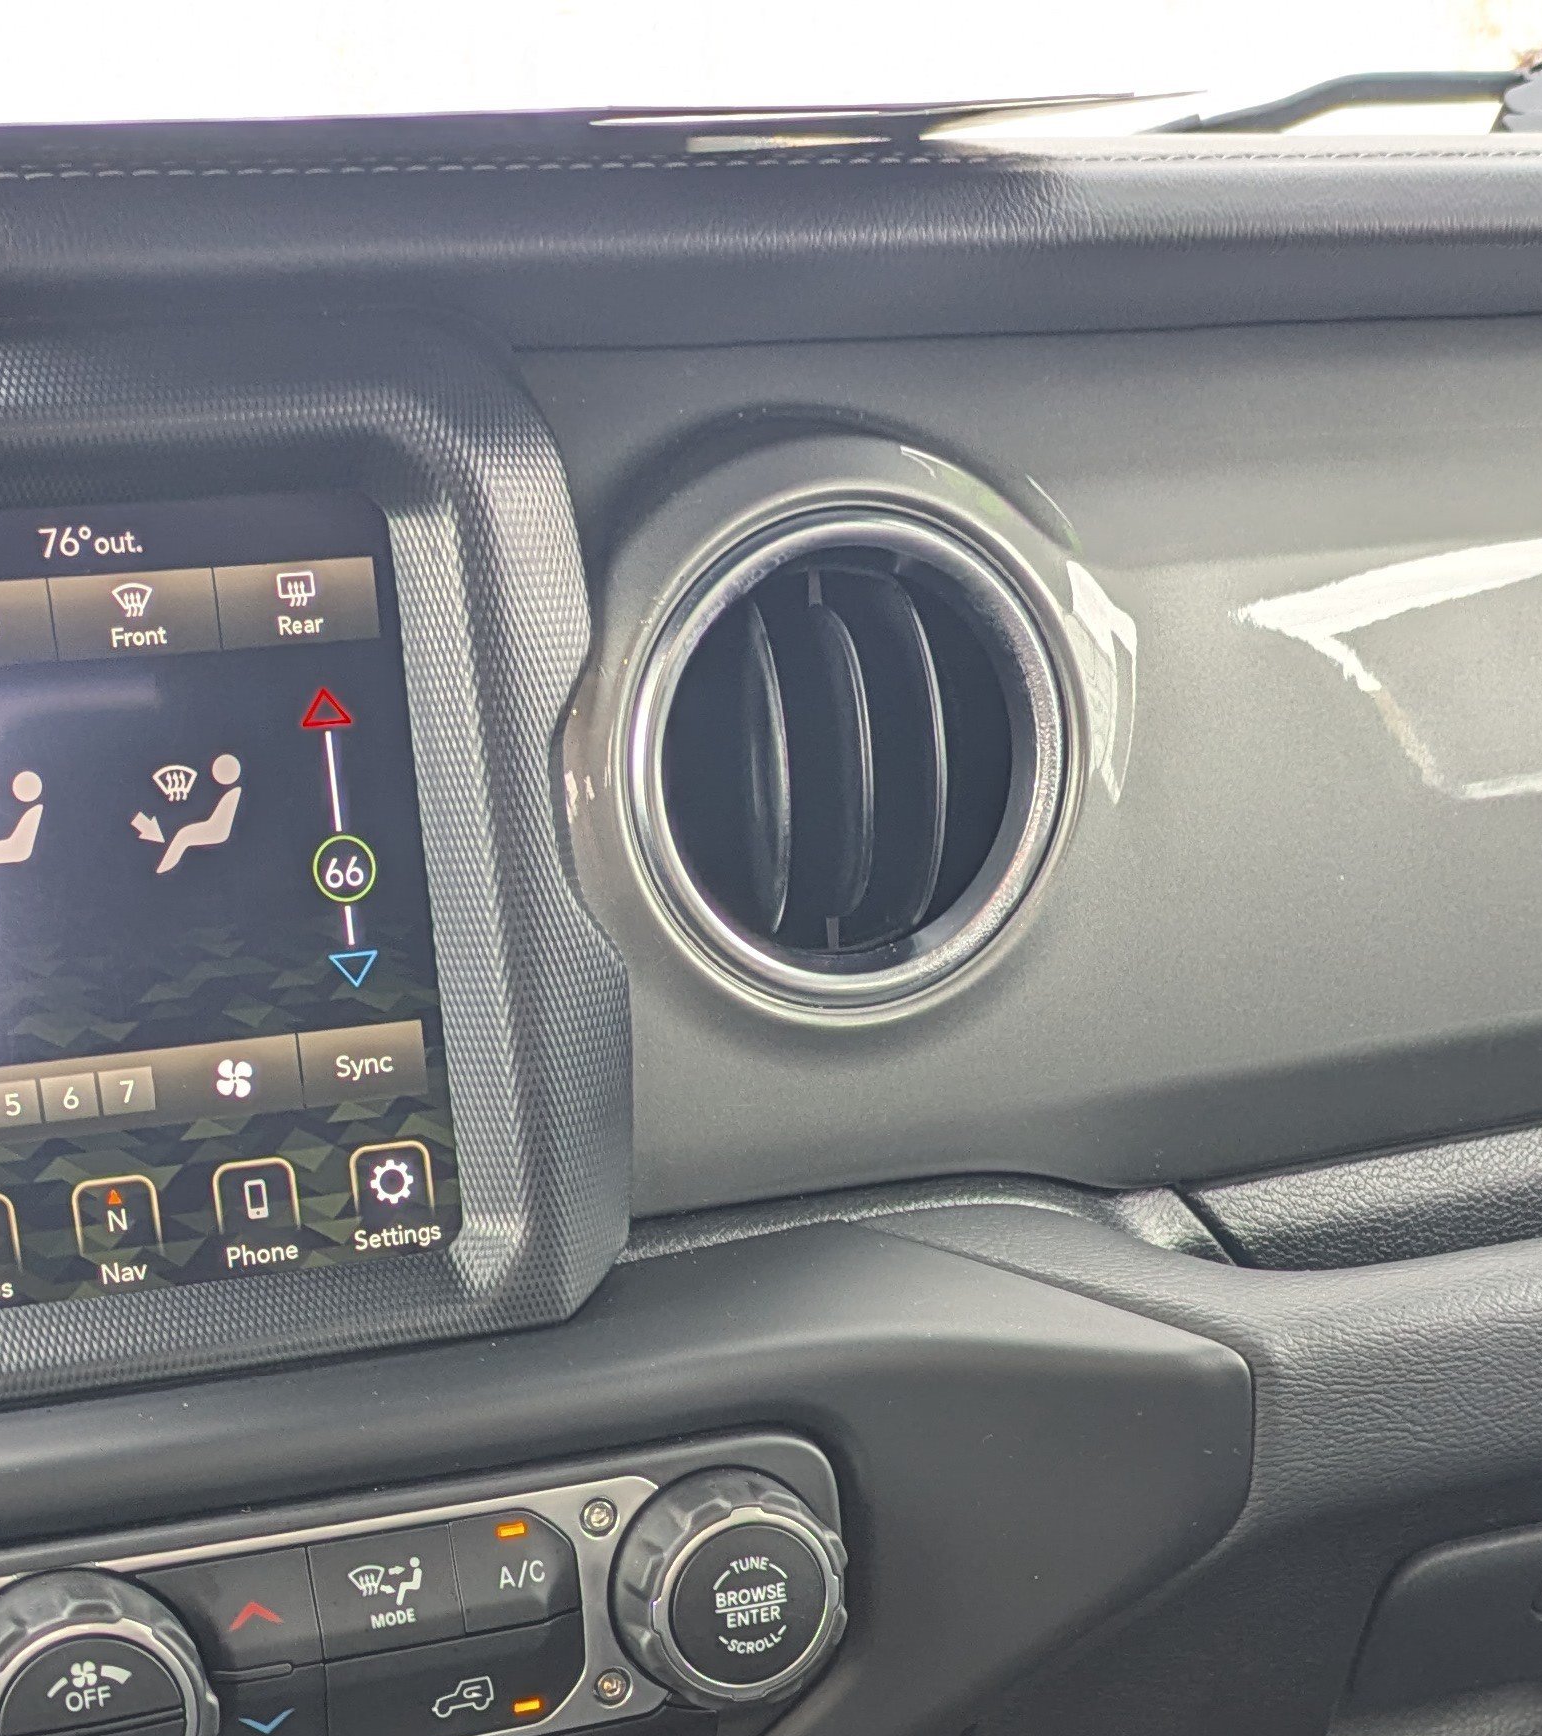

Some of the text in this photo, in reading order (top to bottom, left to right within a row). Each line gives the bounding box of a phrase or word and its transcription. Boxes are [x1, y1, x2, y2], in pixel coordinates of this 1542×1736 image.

[110, 624, 168, 648] Front
[277, 614, 325, 637] Rear
[325, 856, 364, 888] 66
[335, 1054, 394, 1083] Sync
[63, 1087, 80, 1110] 6
[118, 1080, 135, 1104] 7
[5, 1093, 21, 1117] 5
[106, 1210, 128, 1232] N
[353, 1222, 443, 1251] Settings
[226, 1241, 299, 1269] Phone
[100, 1262, 148, 1287] Nav
[498, 1559, 546, 1590] A/C
[730, 1556, 770, 1575] TUNE
[715, 1582, 787, 1609] BROWSE
[370, 1607, 417, 1630] MODE
[726, 1606, 782, 1629] ENTER
[727, 1632, 783, 1655] SCROLL
[65, 1685, 111, 1712] OFF
